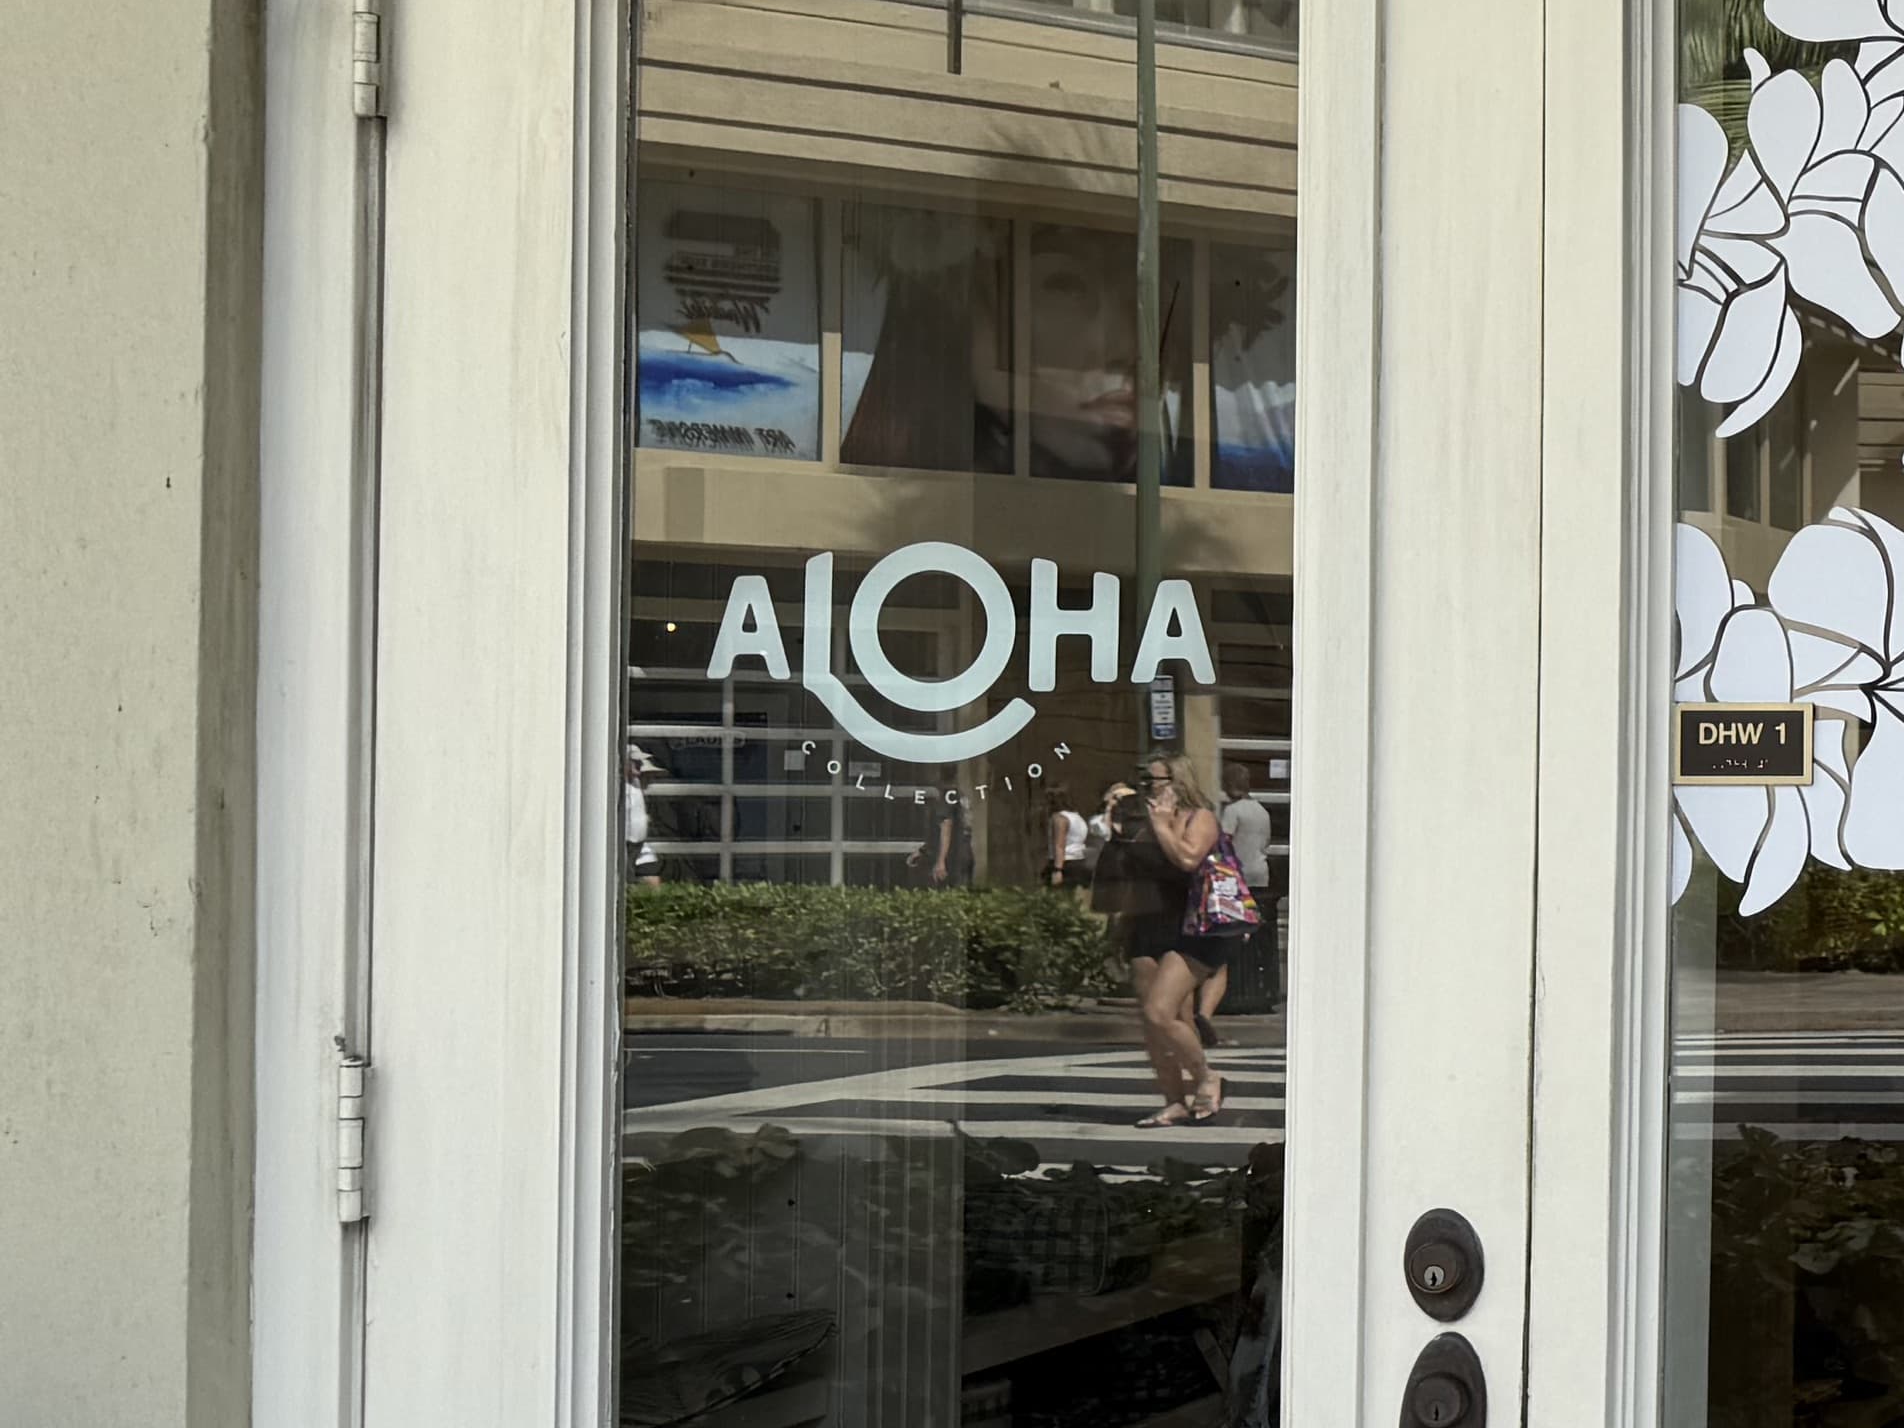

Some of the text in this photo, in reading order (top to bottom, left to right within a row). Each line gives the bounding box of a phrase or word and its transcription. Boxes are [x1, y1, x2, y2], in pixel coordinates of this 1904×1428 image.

[707, 541, 1216, 763] ALOHA
[1699, 722, 1786, 745] DHW 1
[801, 740, 1072, 806] COLLECTION
